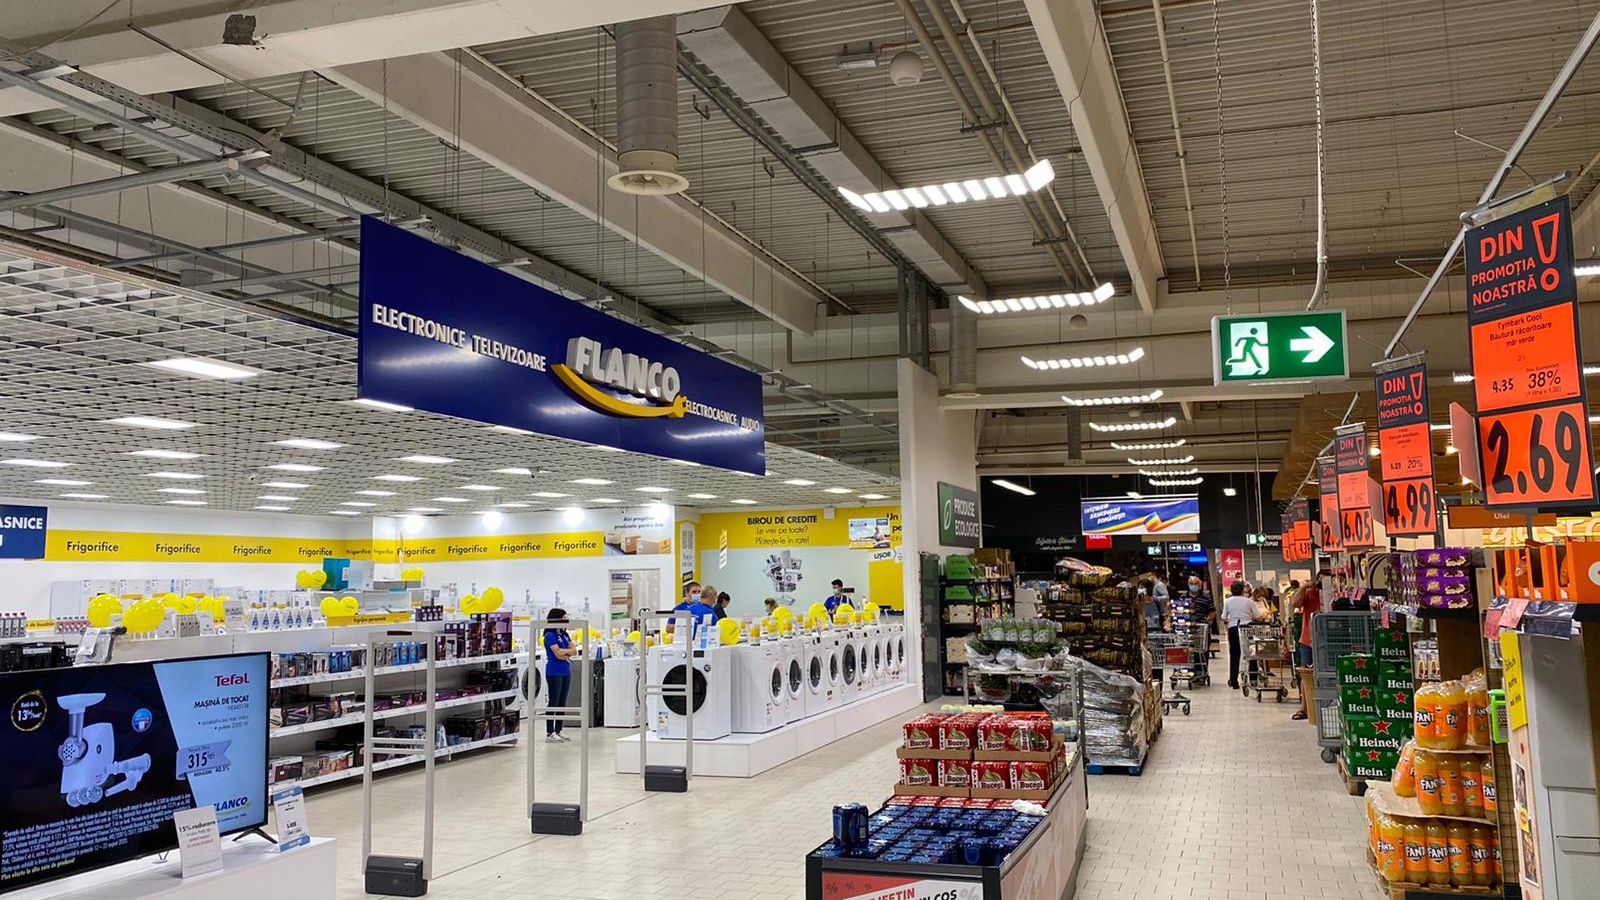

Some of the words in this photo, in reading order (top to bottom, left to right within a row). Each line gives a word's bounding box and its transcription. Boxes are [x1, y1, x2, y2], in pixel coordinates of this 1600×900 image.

[1480, 226, 1523, 263] DIN
[1471, 257, 1536, 287] PROMOȚIA
[1472, 274, 1537, 306] NOASTRĂ
[1497, 316, 1524, 330] Tymbark
[1526, 313, 1542, 323] Cool
[372, 303, 465, 348] ELECTRONICE
[472, 335, 546, 372] TELEVIZOARE
[1518, 336, 1536, 344] verde
[565, 336, 680, 403] FLANCO
[1384, 376, 1406, 394] DIN
[1492, 378, 1514, 393] 4.35
[1528, 369, 1562, 390] 38%
[686, 400, 738, 426] ELECTROCASNICE
[741, 416, 760, 432] AUDIO
[1340, 438, 1354, 450] DIN
[1487, 410, 1582, 494] 2.69
[954, 498, 976, 518] PRODUSE
[1388, 482, 1430, 529] 4.99
[747, 517, 772, 525] BIROU
[786, 514, 818, 524] CREDITE
[1344, 510, 1372, 542] 6.05
[954, 520, 980, 538] ECOLOGICE
[66, 541, 119, 554] Frigorifice
[155, 543, 201, 556] Frigorifice
[233, 544, 272, 556] Frigorifice
[298, 547, 333, 558] Frigorifice
[448, 546, 488, 556] Frigorifice
[500, 543, 542, 553] Frigorifice
[554, 540, 598, 552] Frigorifice
[214, 672, 250, 687] Tefal
[194, 697, 220, 709] MAȘINĂ
[231, 694, 249, 704] TOCAT
[910, 738, 931, 747] Bucegi
[947, 738, 969, 747] Bucegi
[188, 752, 208, 769] 315
[908, 775, 931, 783] Bucegi
[946, 774, 969, 782] Bucegi
[1020, 780, 1042, 789] Bucegi
[214, 796, 248, 812] LANCO
